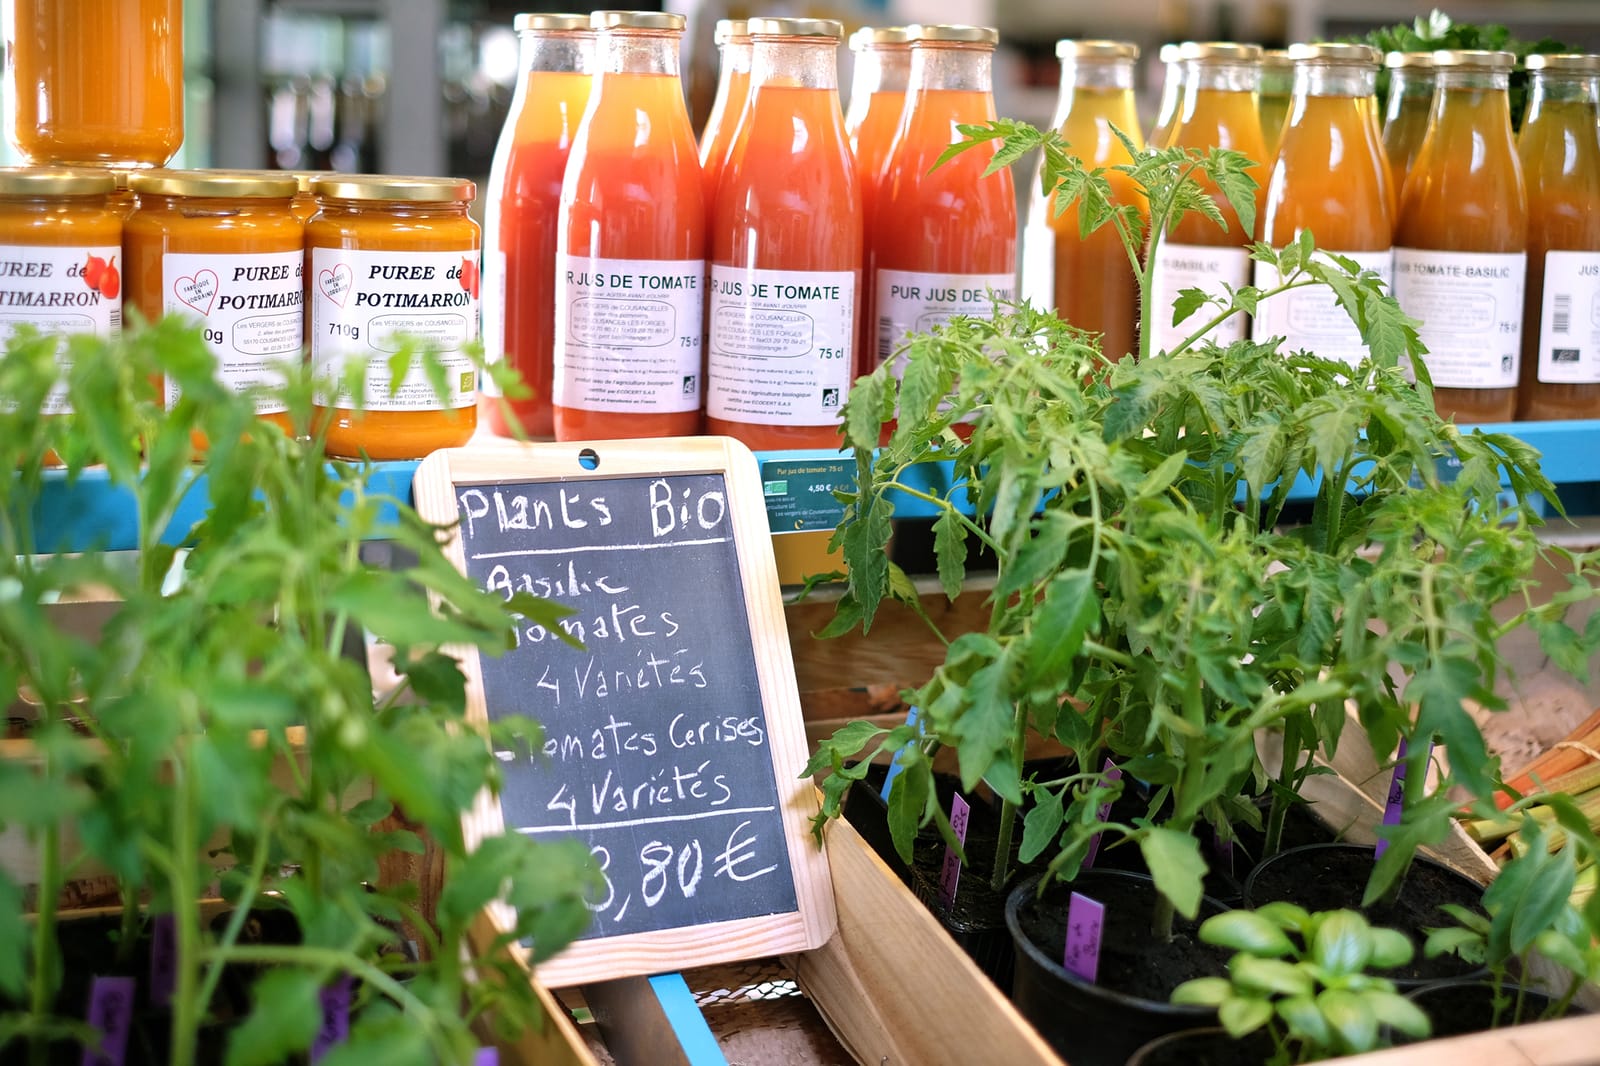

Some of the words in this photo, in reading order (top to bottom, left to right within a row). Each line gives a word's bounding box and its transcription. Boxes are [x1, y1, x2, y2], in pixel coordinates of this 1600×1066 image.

[66, 262, 88, 278] de
[232, 265, 289, 281] PUREE
[368, 265, 435, 280] PUREE
[446, 265, 462, 279] de
[1412, 264, 1510, 278] TOMATE-BASILIC
[1578, 265, 1599, 276] JUS
[577, 272, 604, 287] JUS
[610, 274, 632, 289] DE
[638, 275, 697, 289] TOMATE
[720, 281, 742, 296] JUS
[748, 284, 768, 298] DE
[774, 285, 840, 300] TOMATE
[891, 285, 920, 300] PUR
[925, 288, 957, 302] JUS
[962, 289, 982, 302] DE
[355, 291, 471, 308] POTIMARRON
[620, 304, 668, 312] COUSANCELLES
[203, 328, 223, 344] 0g
[329, 323, 359, 340] 710g
[680, 336, 691, 347] 75
[819, 348, 833, 359] 75
[835, 348, 844, 359] cl
[808, 484, 824, 493] 4,50
[460, 488, 612, 539] Plants
[487, 560, 629, 601] Basilic
[536, 664, 560, 705] 4
[574, 648, 708, 699] Variétés
[669, 713, 764, 749] Cerises
[546, 784, 577, 827] 4
[592, 760, 731, 815] Variétés
